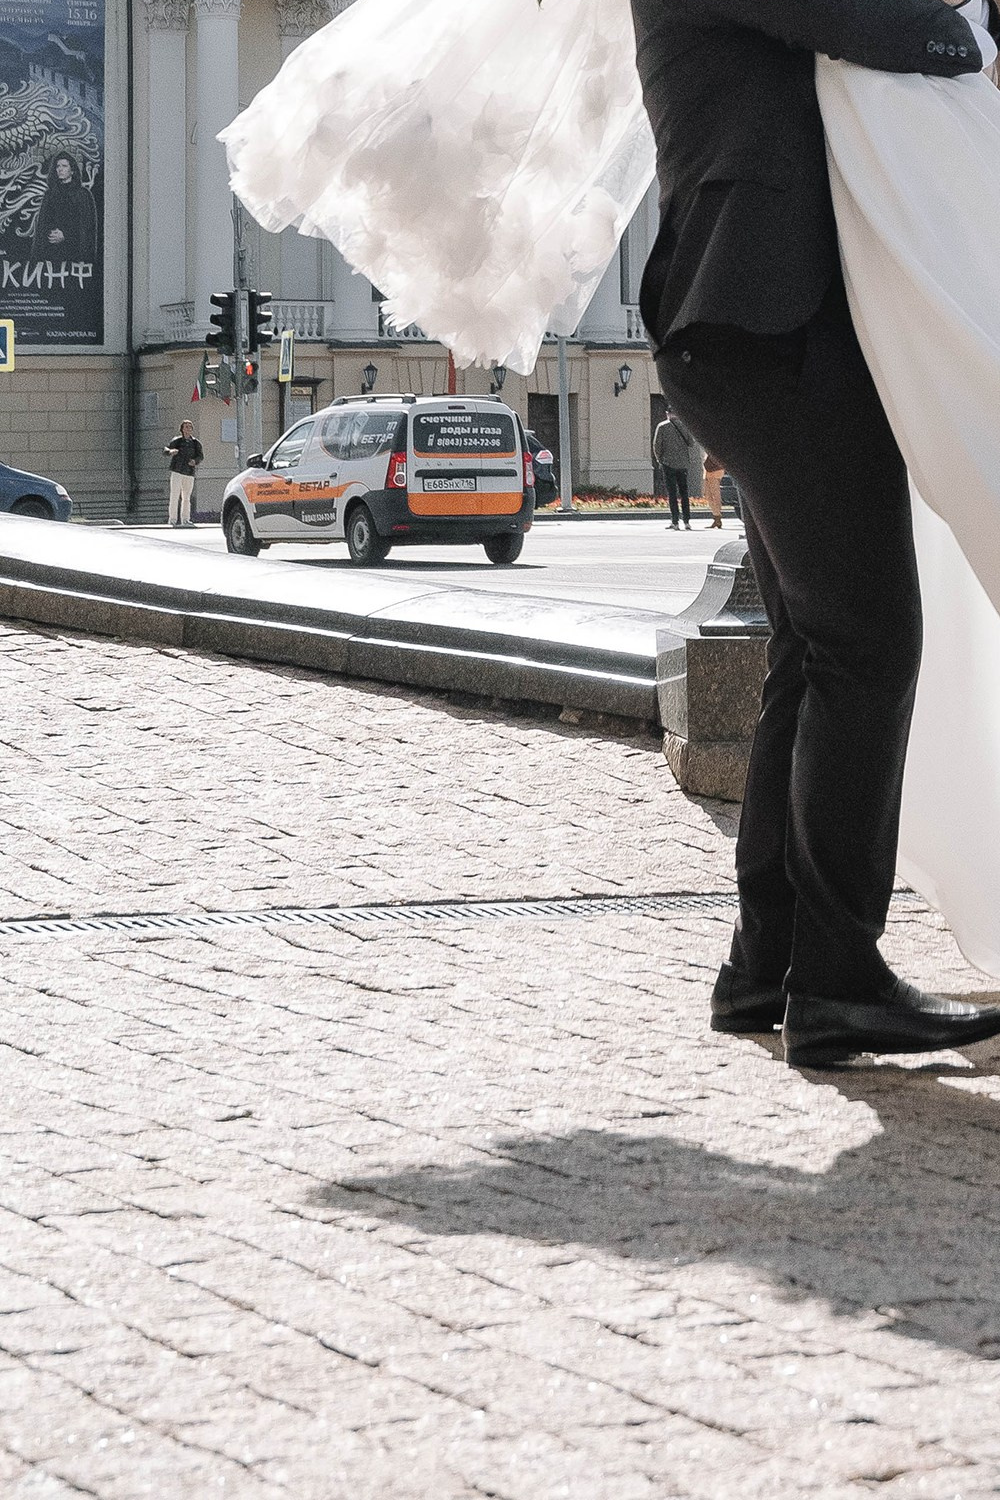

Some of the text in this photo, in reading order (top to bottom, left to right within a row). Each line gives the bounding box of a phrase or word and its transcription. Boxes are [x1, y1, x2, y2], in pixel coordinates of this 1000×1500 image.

[420, 415, 472, 424] счетчики
[440, 426, 471, 435] воды
[480, 427, 502, 435] газа
[361, 433, 394, 444] БЕТАР
[298, 480, 330, 492] БЕТАР
